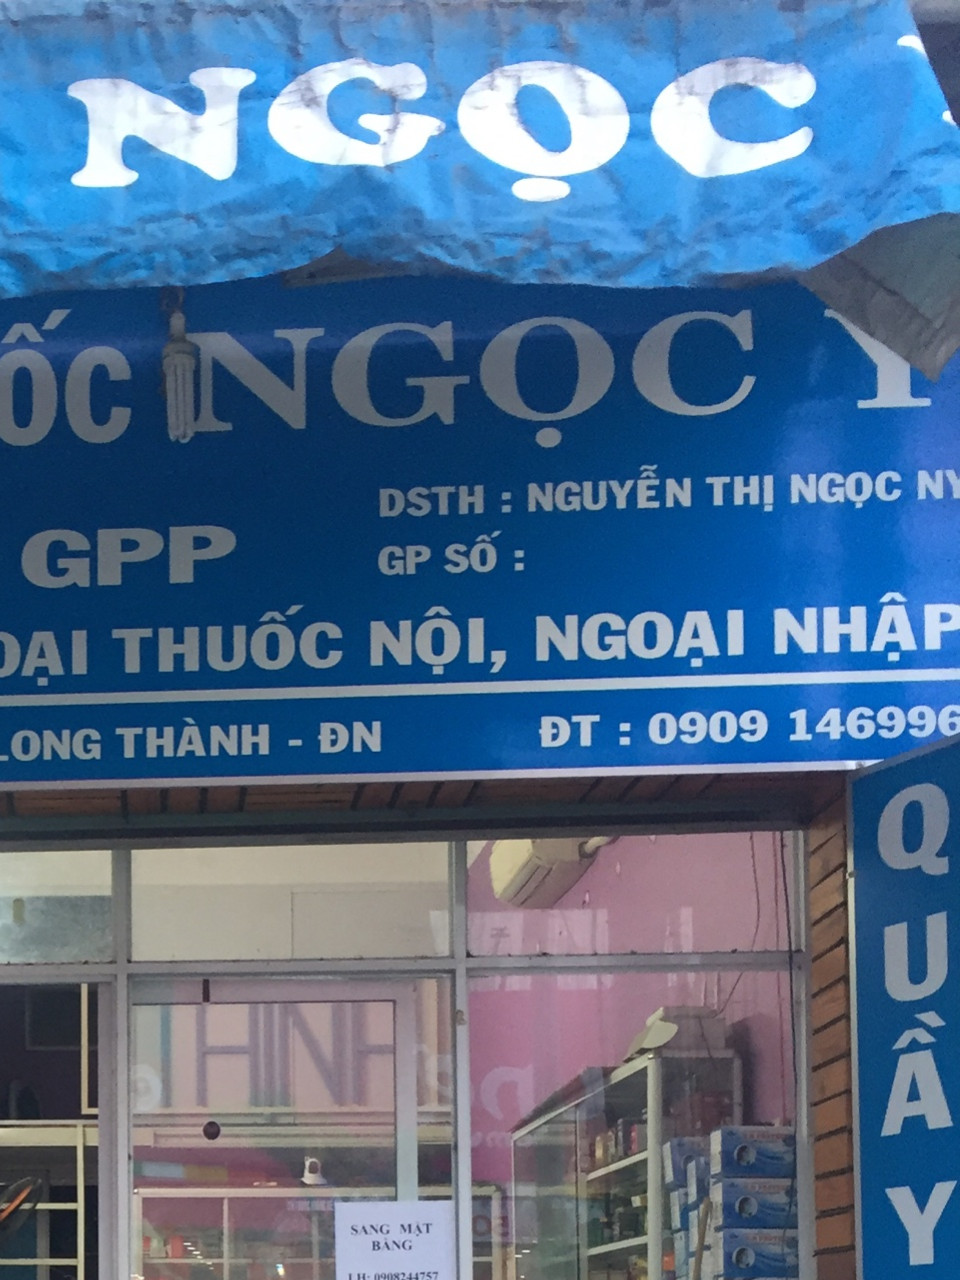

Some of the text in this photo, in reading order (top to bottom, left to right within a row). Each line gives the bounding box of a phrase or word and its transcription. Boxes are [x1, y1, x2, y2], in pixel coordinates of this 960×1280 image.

[66, 57, 816, 202] NGỌC
[186, 308, 757, 448] NGỌC
[379, 484, 484, 517] DSTH
[527, 464, 692, 513] NGUYỄN
[706, 474, 775, 512] THỊ
[790, 470, 902, 509] NGỌC
[21, 525, 237, 589] GPP
[378, 545, 431, 576] GP
[444, 530, 502, 574] SỐ
[112, 604, 343, 674] THUỐC
[369, 605, 507, 674] NỘI,
[535, 609, 744, 668] NGOẠI
[773, 591, 960, 662] NHẬP
[115, 717, 270, 758] THÀNH
[318, 721, 382, 754] ĐN
[539, 714, 600, 748] ĐT
[648, 709, 769, 745] 0909
[789, 705, 960, 741] 146996
[877, 782, 957, 1266] QUẦY
[350, 1223, 390, 1235] SANG
